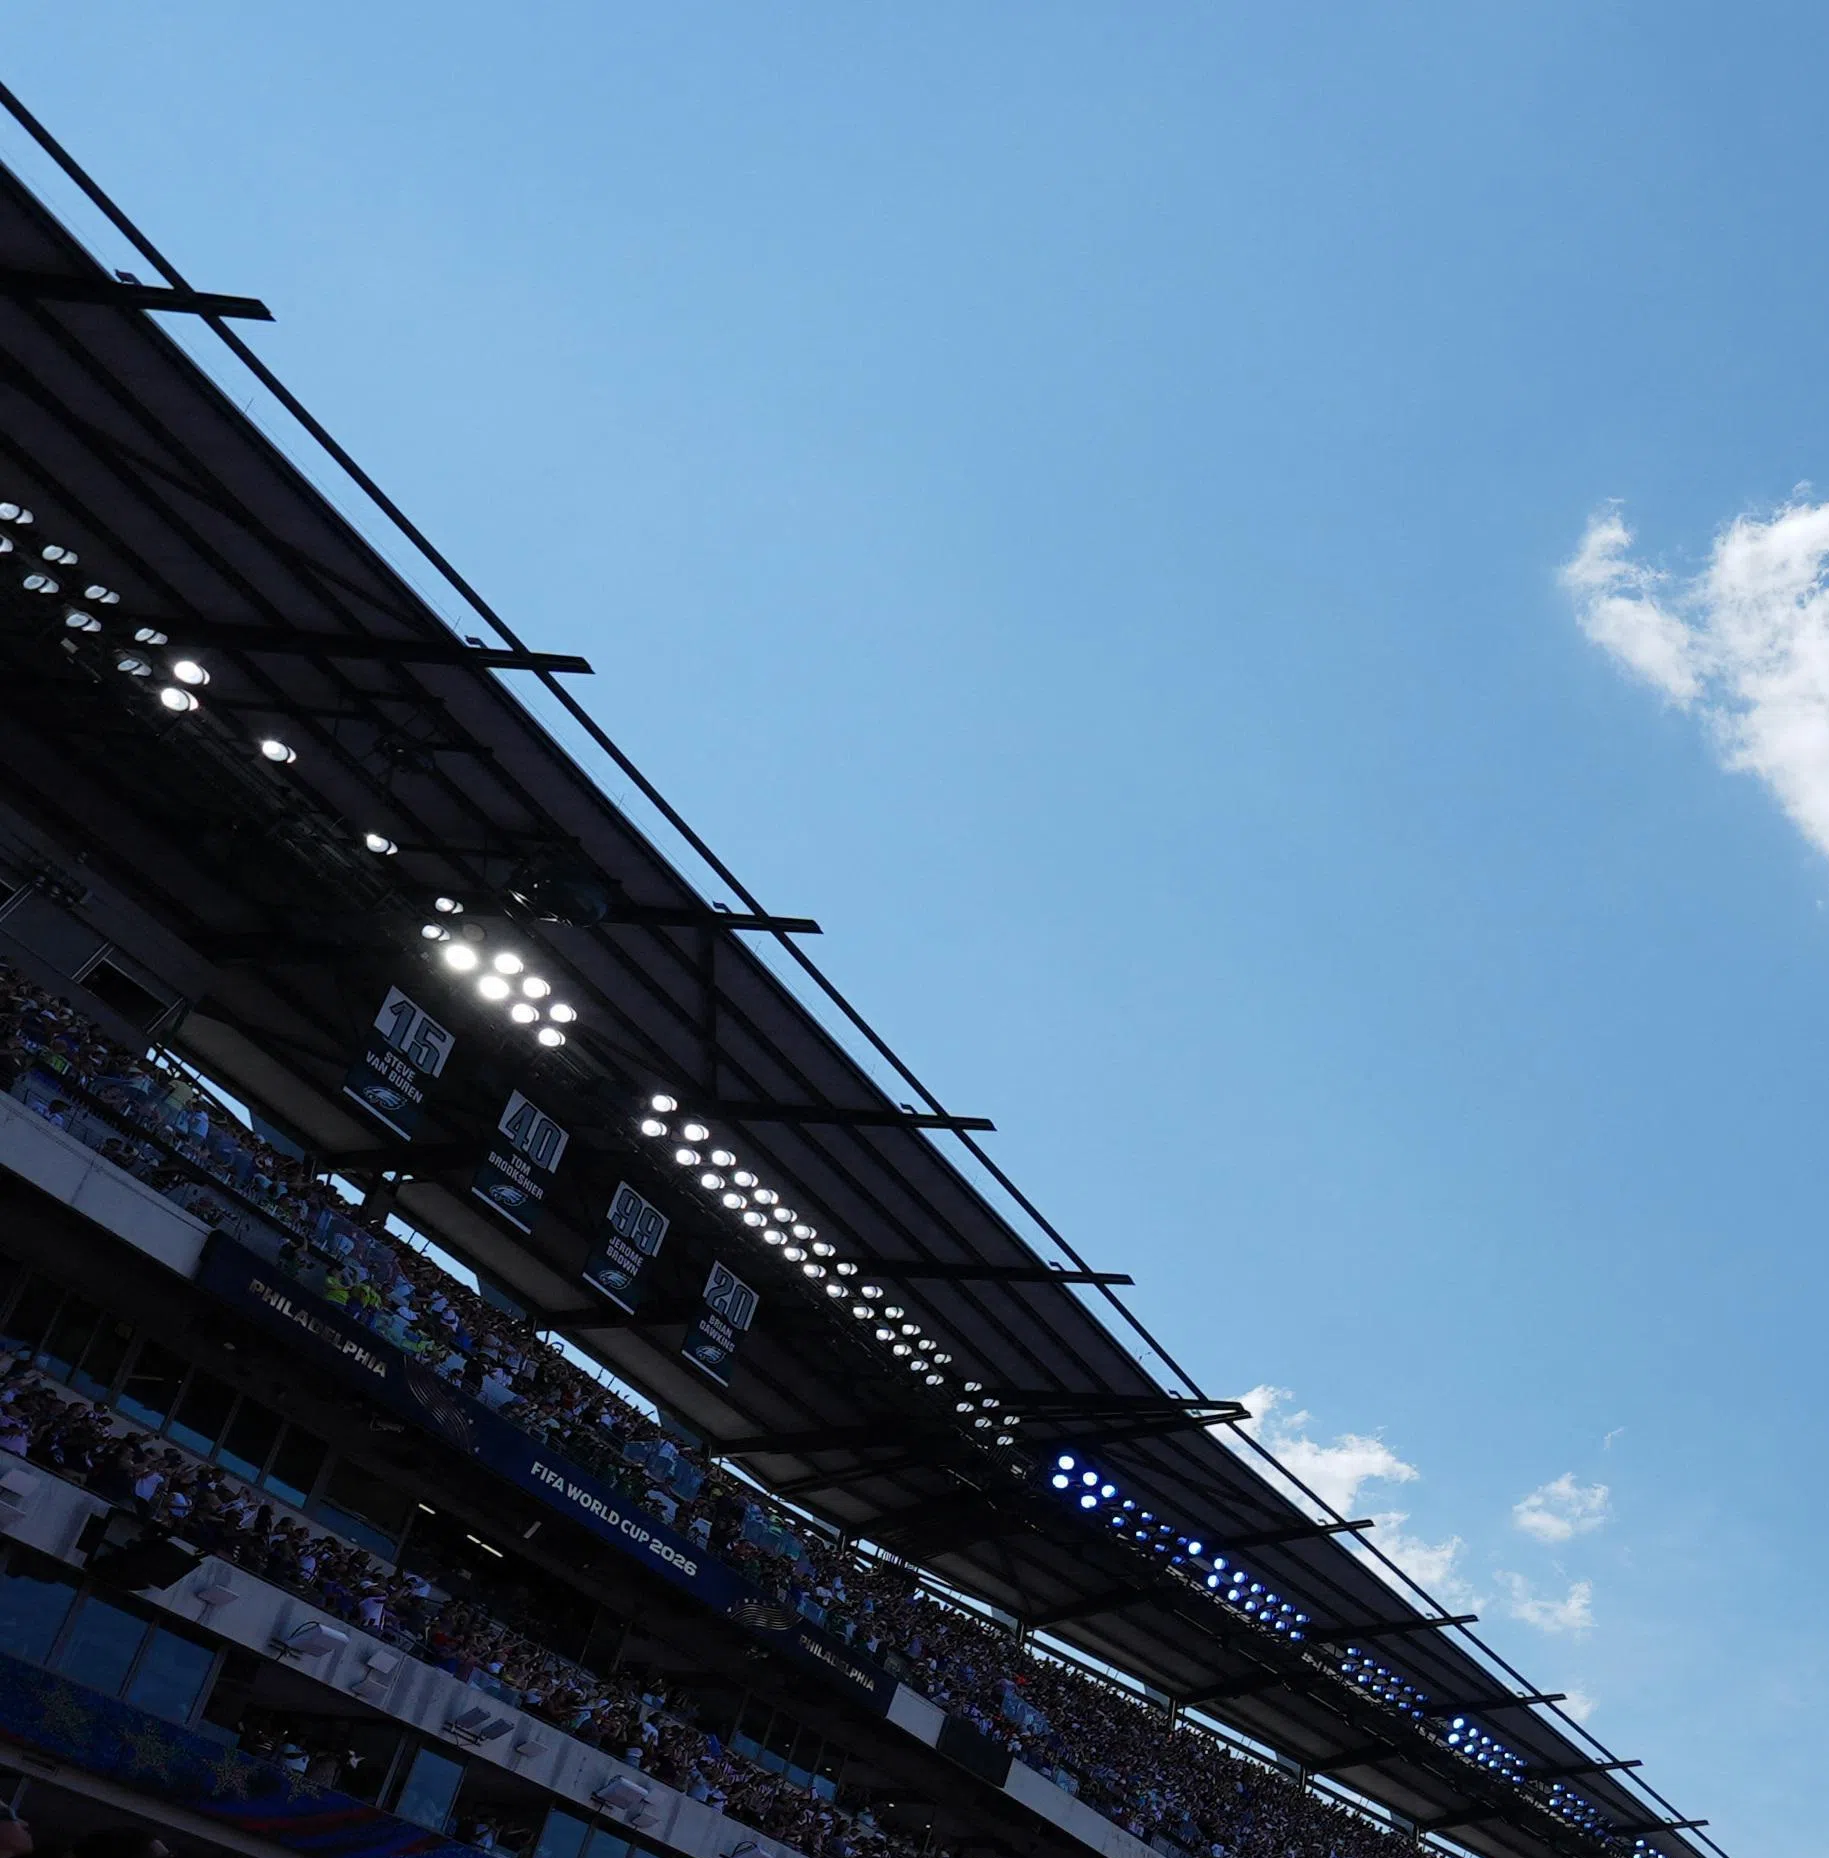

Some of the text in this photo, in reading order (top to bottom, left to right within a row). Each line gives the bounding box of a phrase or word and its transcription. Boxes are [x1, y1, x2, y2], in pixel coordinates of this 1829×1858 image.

[383, 999, 446, 1074] 15
[365, 1050, 424, 1104] VAN BUREN
[383, 1050, 416, 1082] STEVE
[505, 1102, 562, 1169] 40
[487, 1151, 545, 1200] BROOKSHIER
[511, 1153, 532, 1176] TOM
[612, 1188, 665, 1255] 99
[606, 1245, 639, 1276] BROWN
[609, 1235, 644, 1268] JEROME
[704, 1267, 754, 1330] 20
[247, 1279, 389, 1379] PHILADELPHIA
[699, 1319, 736, 1353] DAWKINS
[708, 1313, 734, 1338] BRIAN
[530, 1460, 699, 1578] FIFA WORLD CUP 2026
